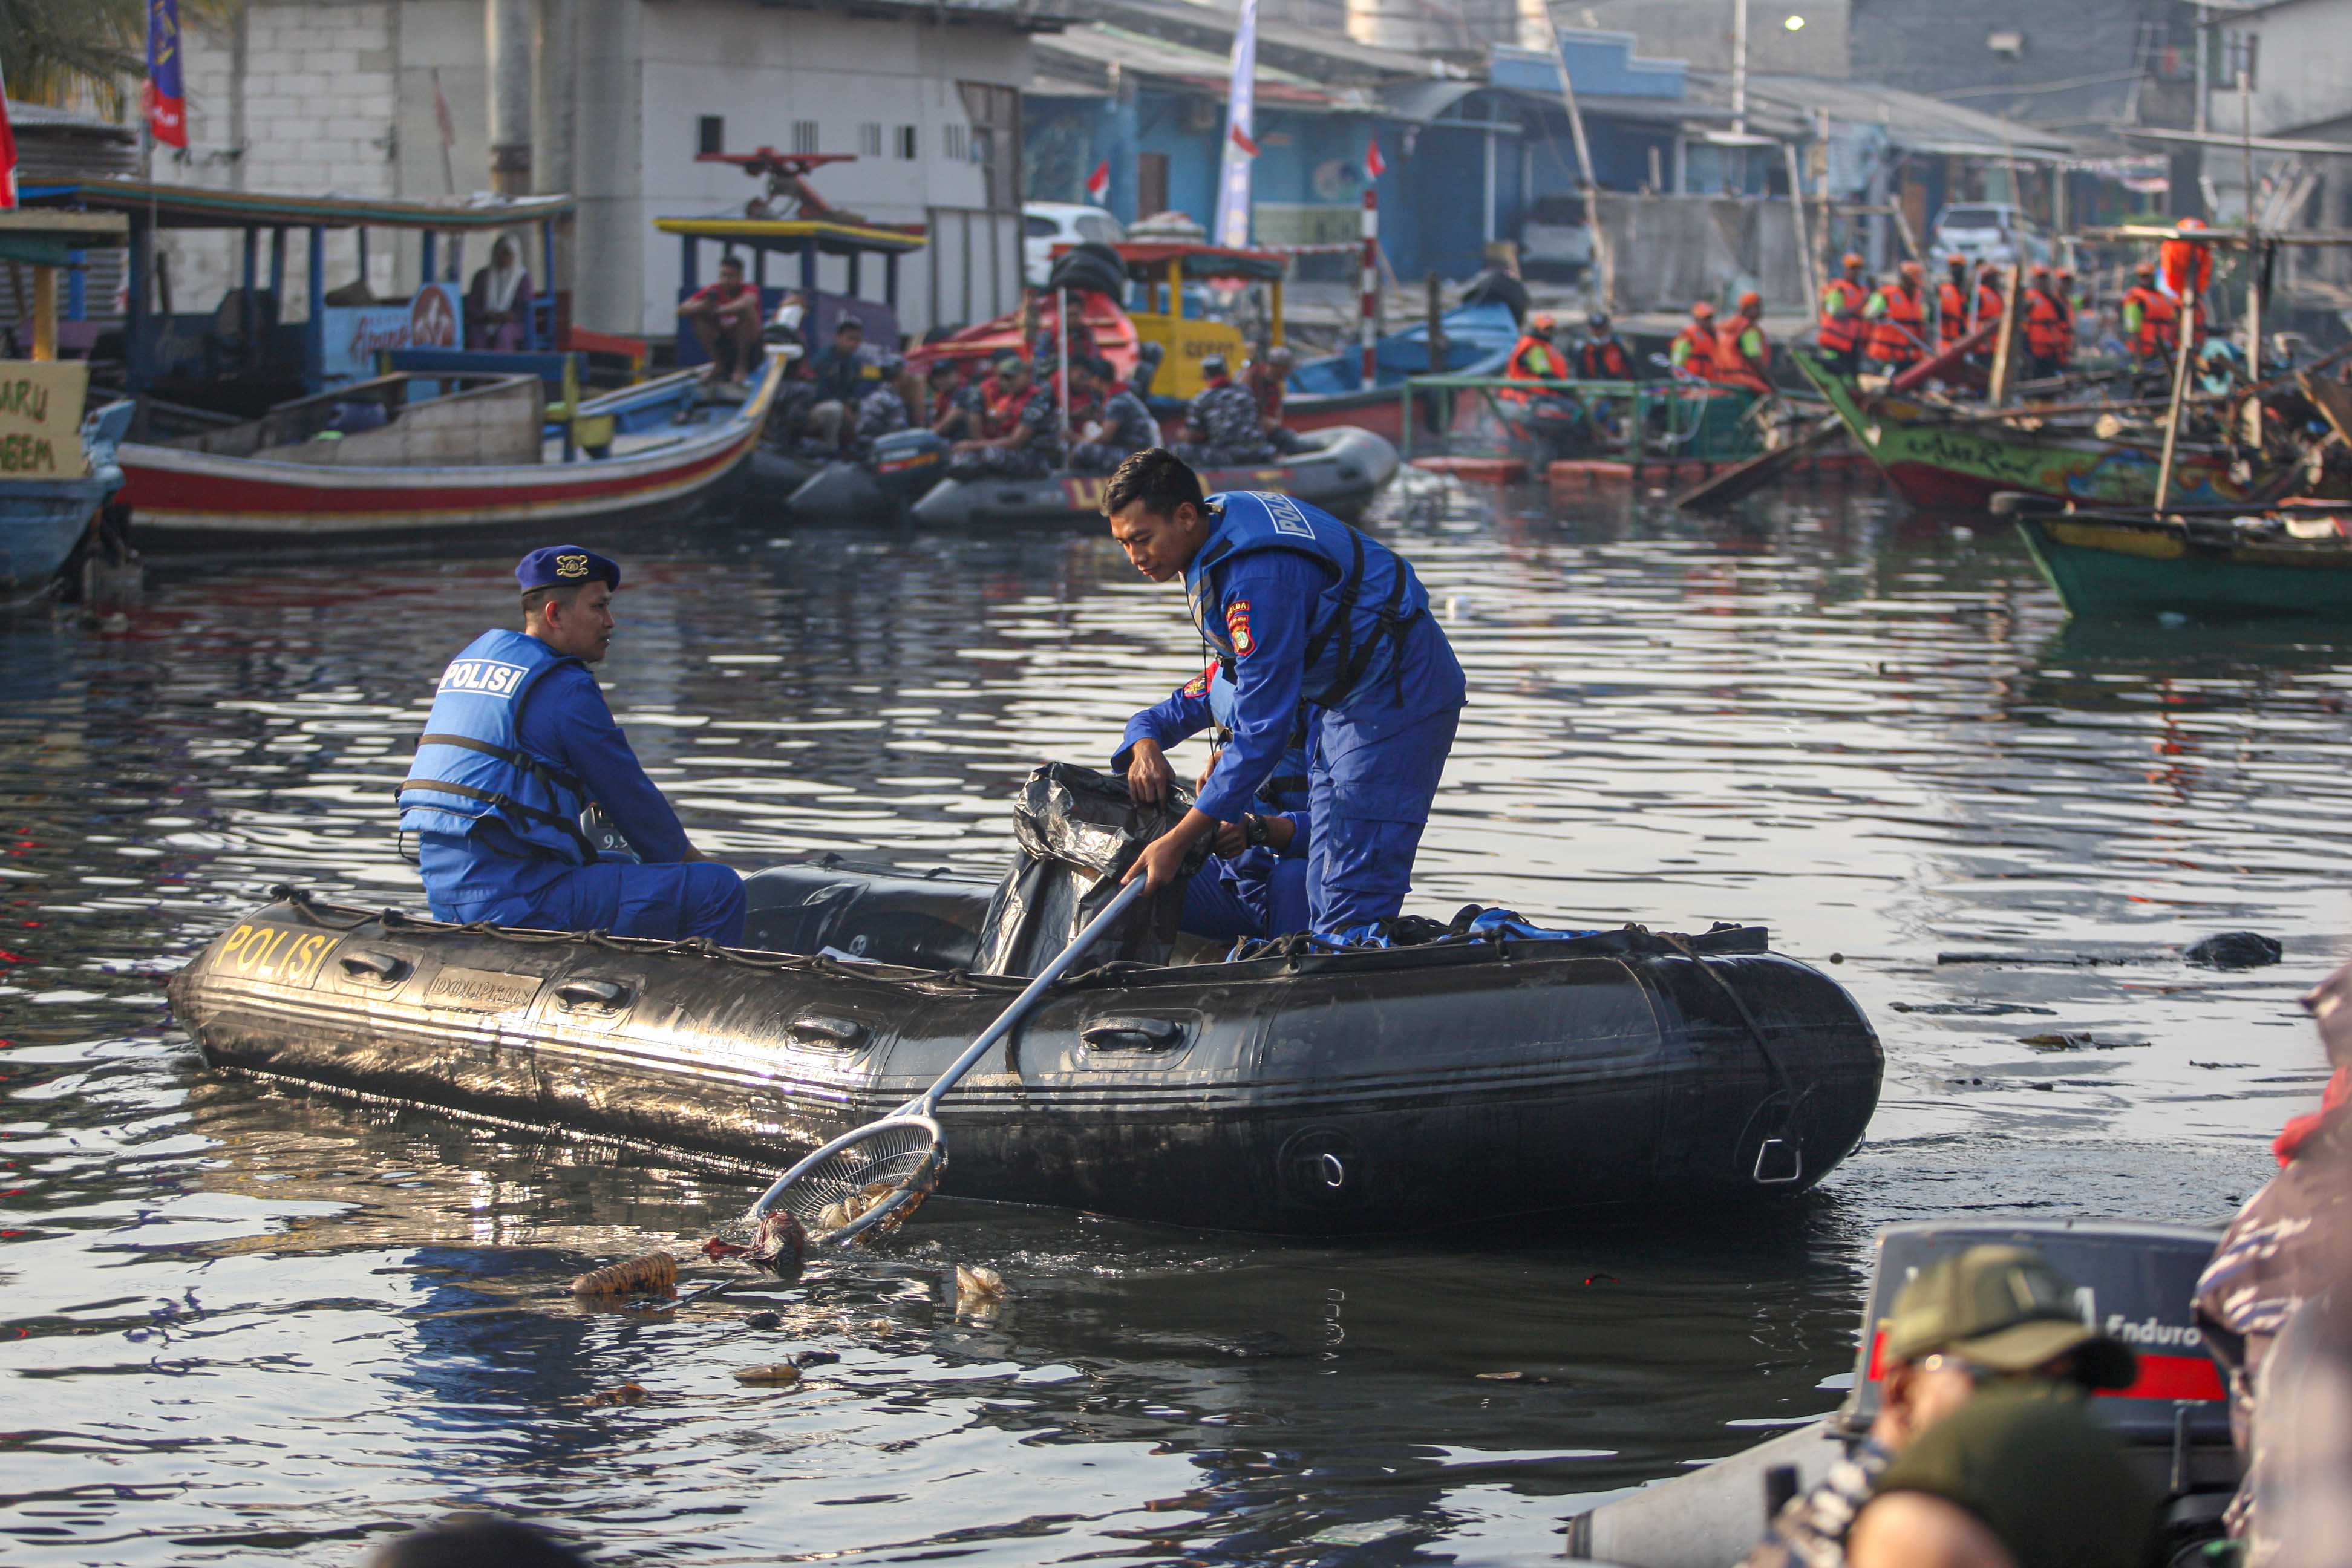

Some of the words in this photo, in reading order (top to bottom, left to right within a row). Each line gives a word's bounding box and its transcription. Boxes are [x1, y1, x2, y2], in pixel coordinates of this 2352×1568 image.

[440, 663, 523, 693] POLISI
[215, 924, 339, 982] POLISI
[429, 976, 535, 1007] DOLPHIN
[2106, 1313, 2203, 1347] Enduro
